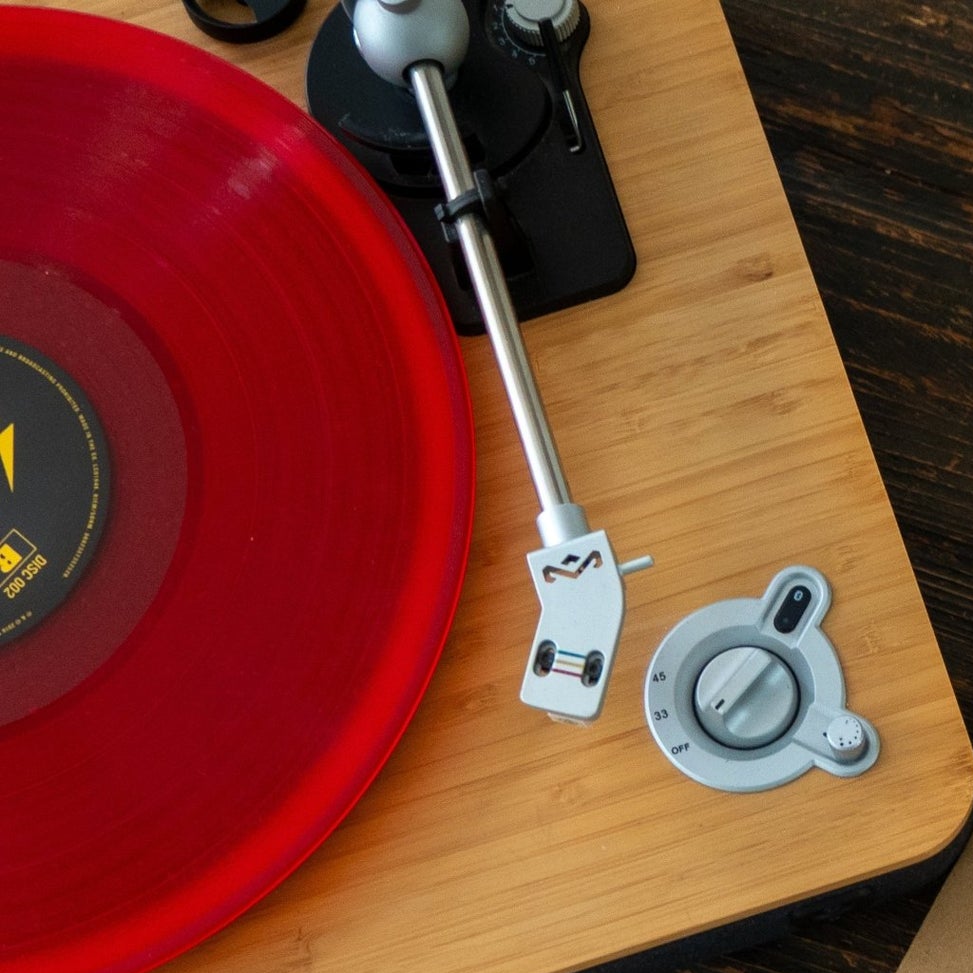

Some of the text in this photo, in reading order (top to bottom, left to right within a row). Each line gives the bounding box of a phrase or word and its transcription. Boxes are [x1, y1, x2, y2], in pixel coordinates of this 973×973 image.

[3, 554, 47, 599] DISC 002
[652, 671, 667, 683] 45
[654, 709, 669, 721] 33
[671, 742, 690, 755] OFF
